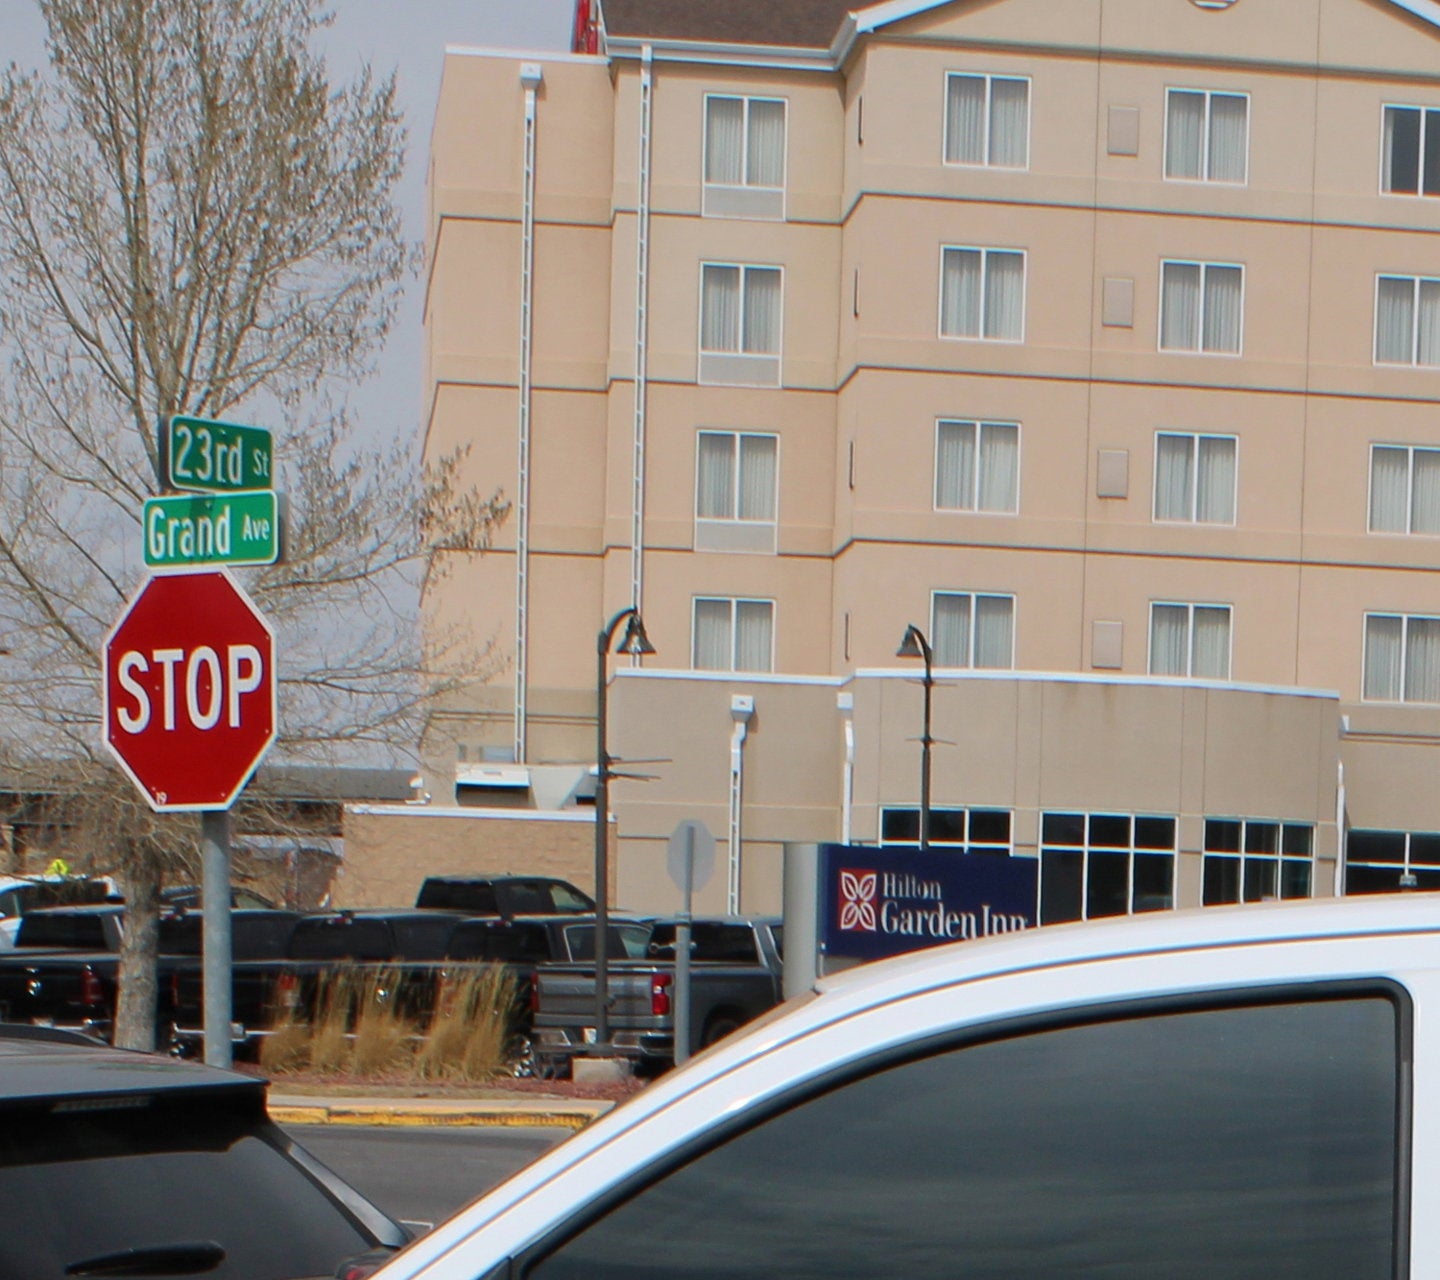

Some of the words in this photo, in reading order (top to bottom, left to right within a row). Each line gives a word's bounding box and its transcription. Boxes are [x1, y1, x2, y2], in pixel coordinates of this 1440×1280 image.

[175, 424, 242, 485] 23rd
[252, 448, 269, 477] St
[148, 504, 230, 560] Grand
[242, 514, 270, 541] Ave
[116, 644, 262, 734] STOP
[883, 872, 942, 900] Hilton
[880, 900, 978, 940] Garden
[981, 904, 1026, 937] Inn
